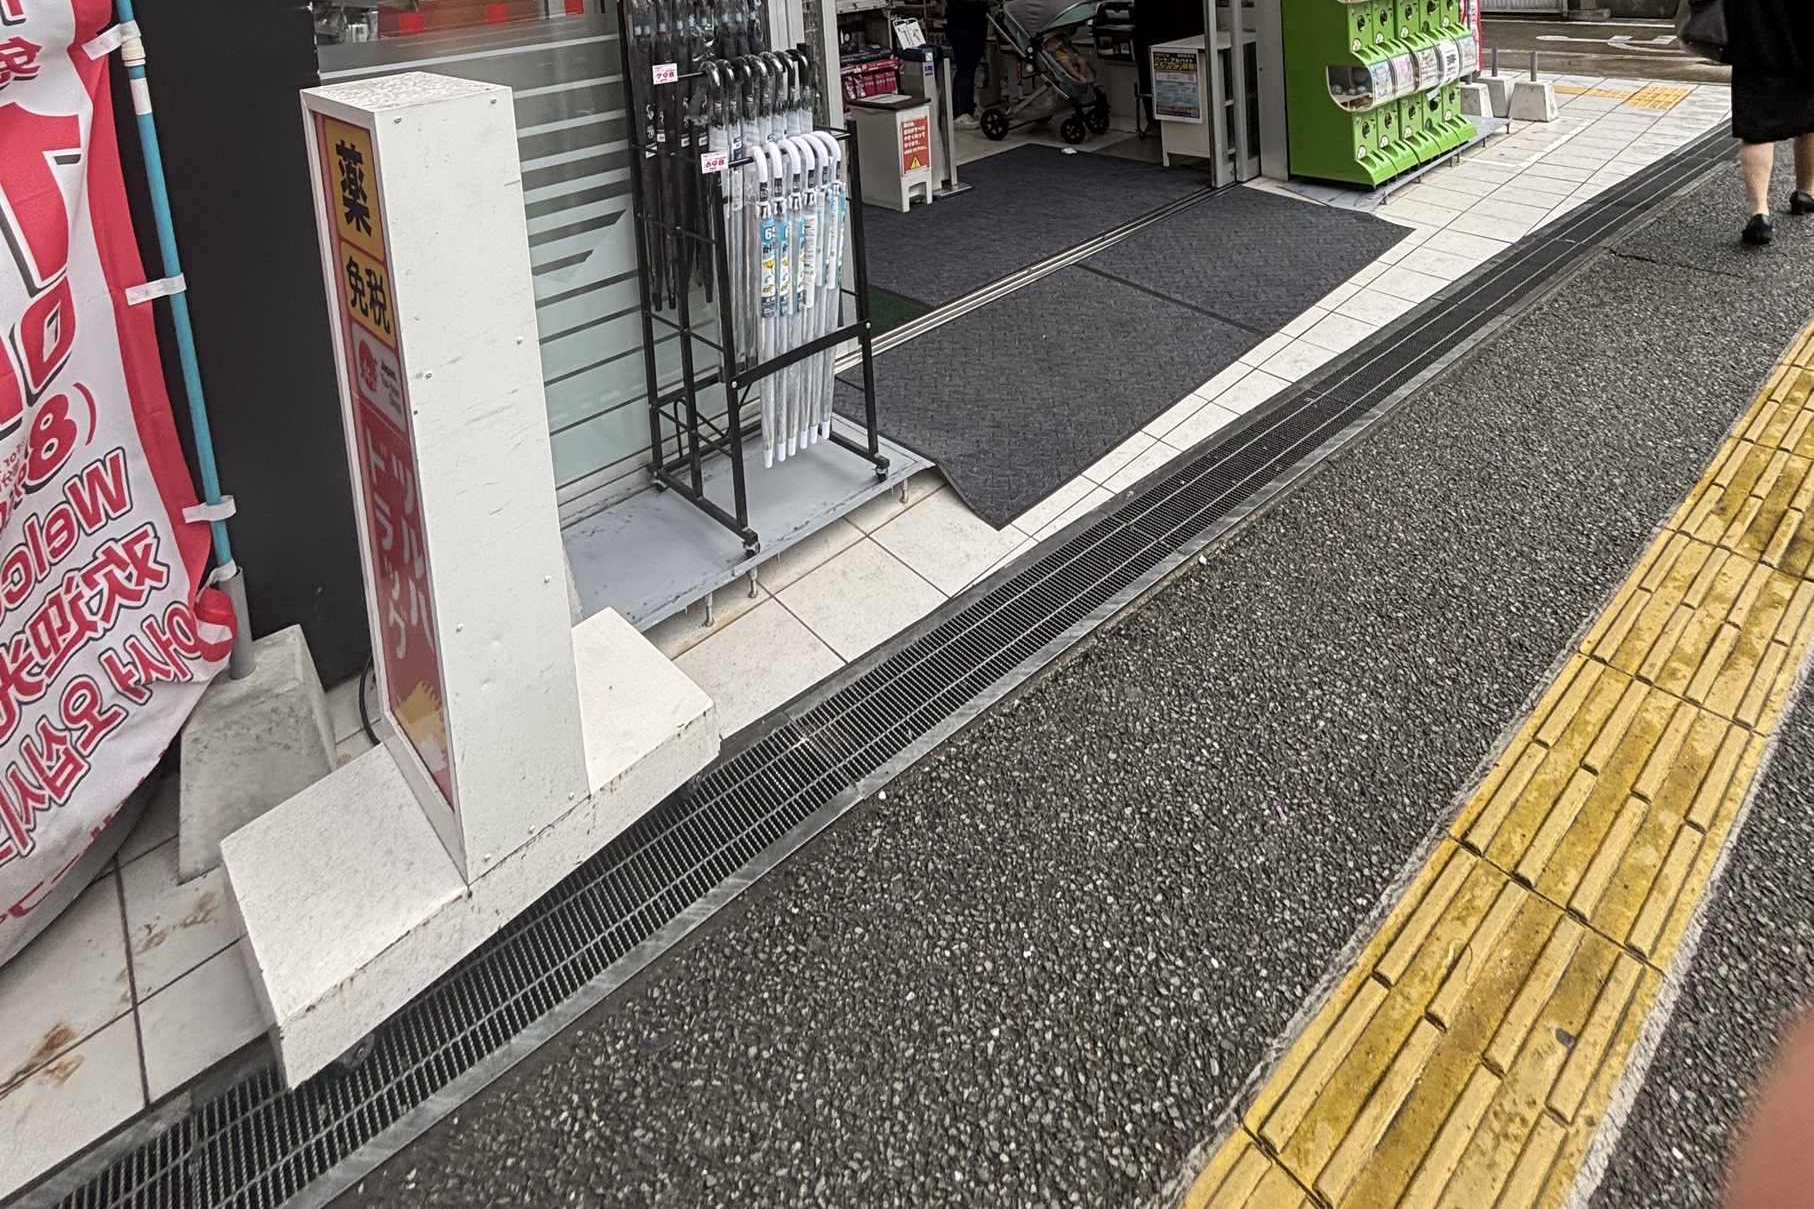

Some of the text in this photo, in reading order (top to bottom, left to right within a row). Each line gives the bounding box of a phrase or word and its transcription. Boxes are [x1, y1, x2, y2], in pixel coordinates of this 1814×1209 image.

[656, 71, 674, 79] 798
[335, 139, 373, 237] 薬
[706, 159, 724, 168] 698
[346, 255, 391, 336] 免税
[366, 426, 408, 660] ドラッグ
[391, 452, 436, 654] ツルハ
